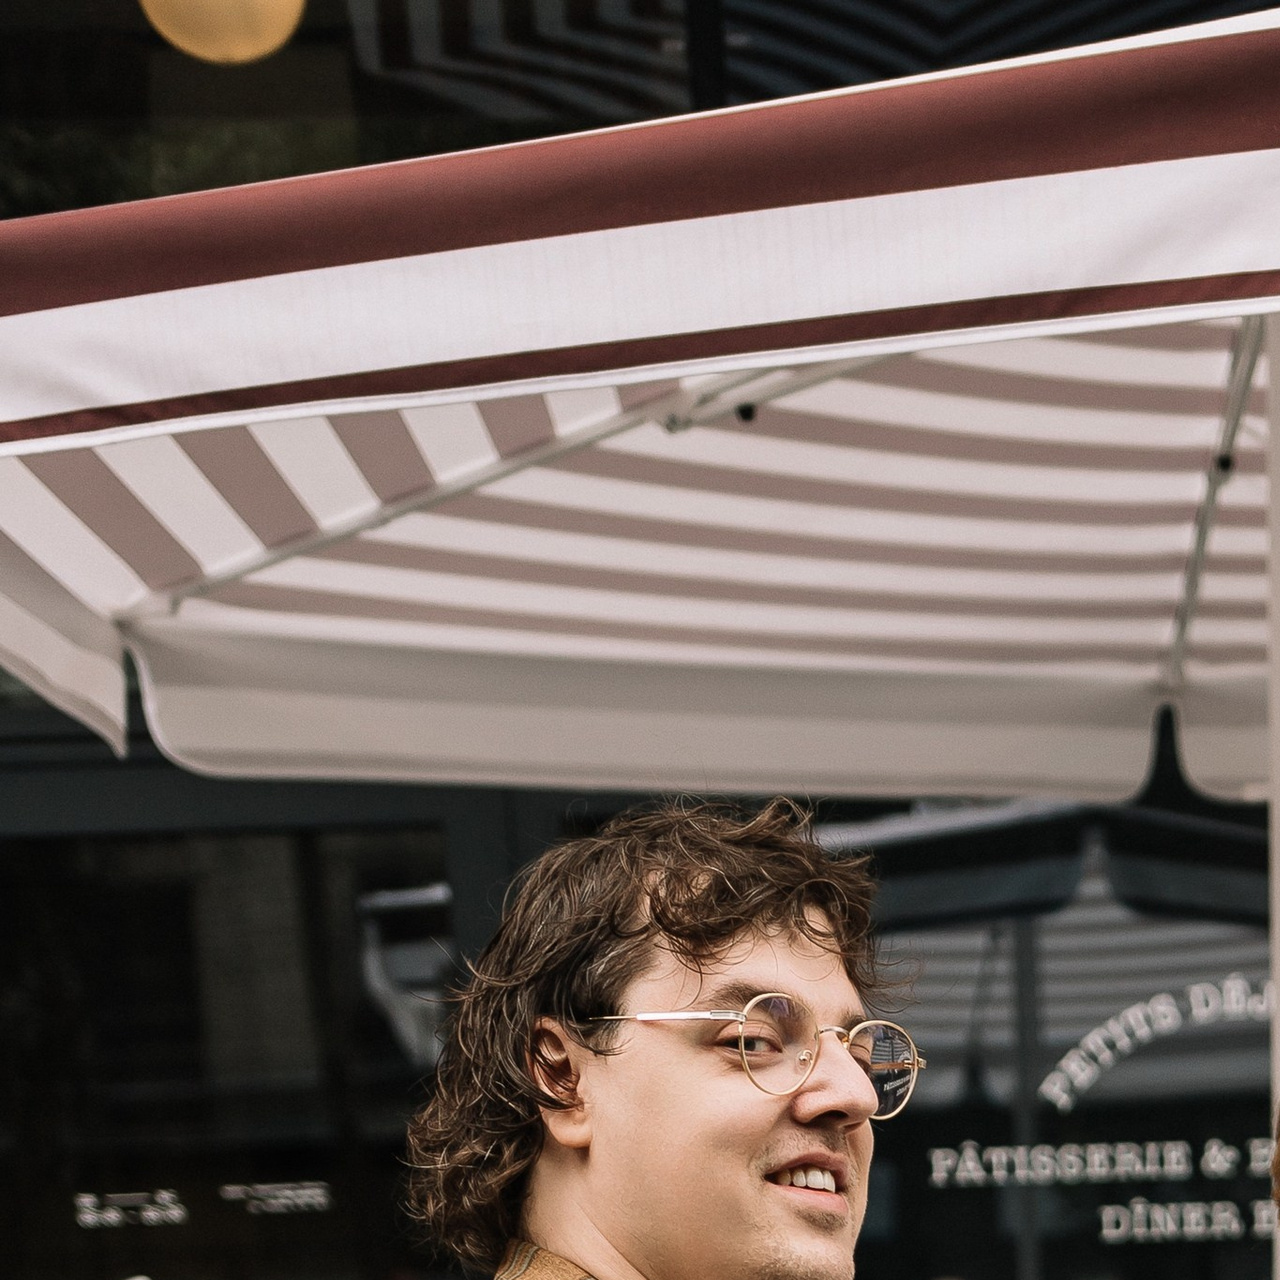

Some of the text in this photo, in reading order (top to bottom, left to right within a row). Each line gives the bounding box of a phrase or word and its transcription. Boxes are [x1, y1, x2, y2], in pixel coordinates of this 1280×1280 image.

[1038, 992, 1183, 1113] PETITS
[928, 1139, 1193, 1187] PÂTISSERIE
[1200, 1138, 1241, 1179] &
[1100, 1196, 1245, 1244] DÎNER
